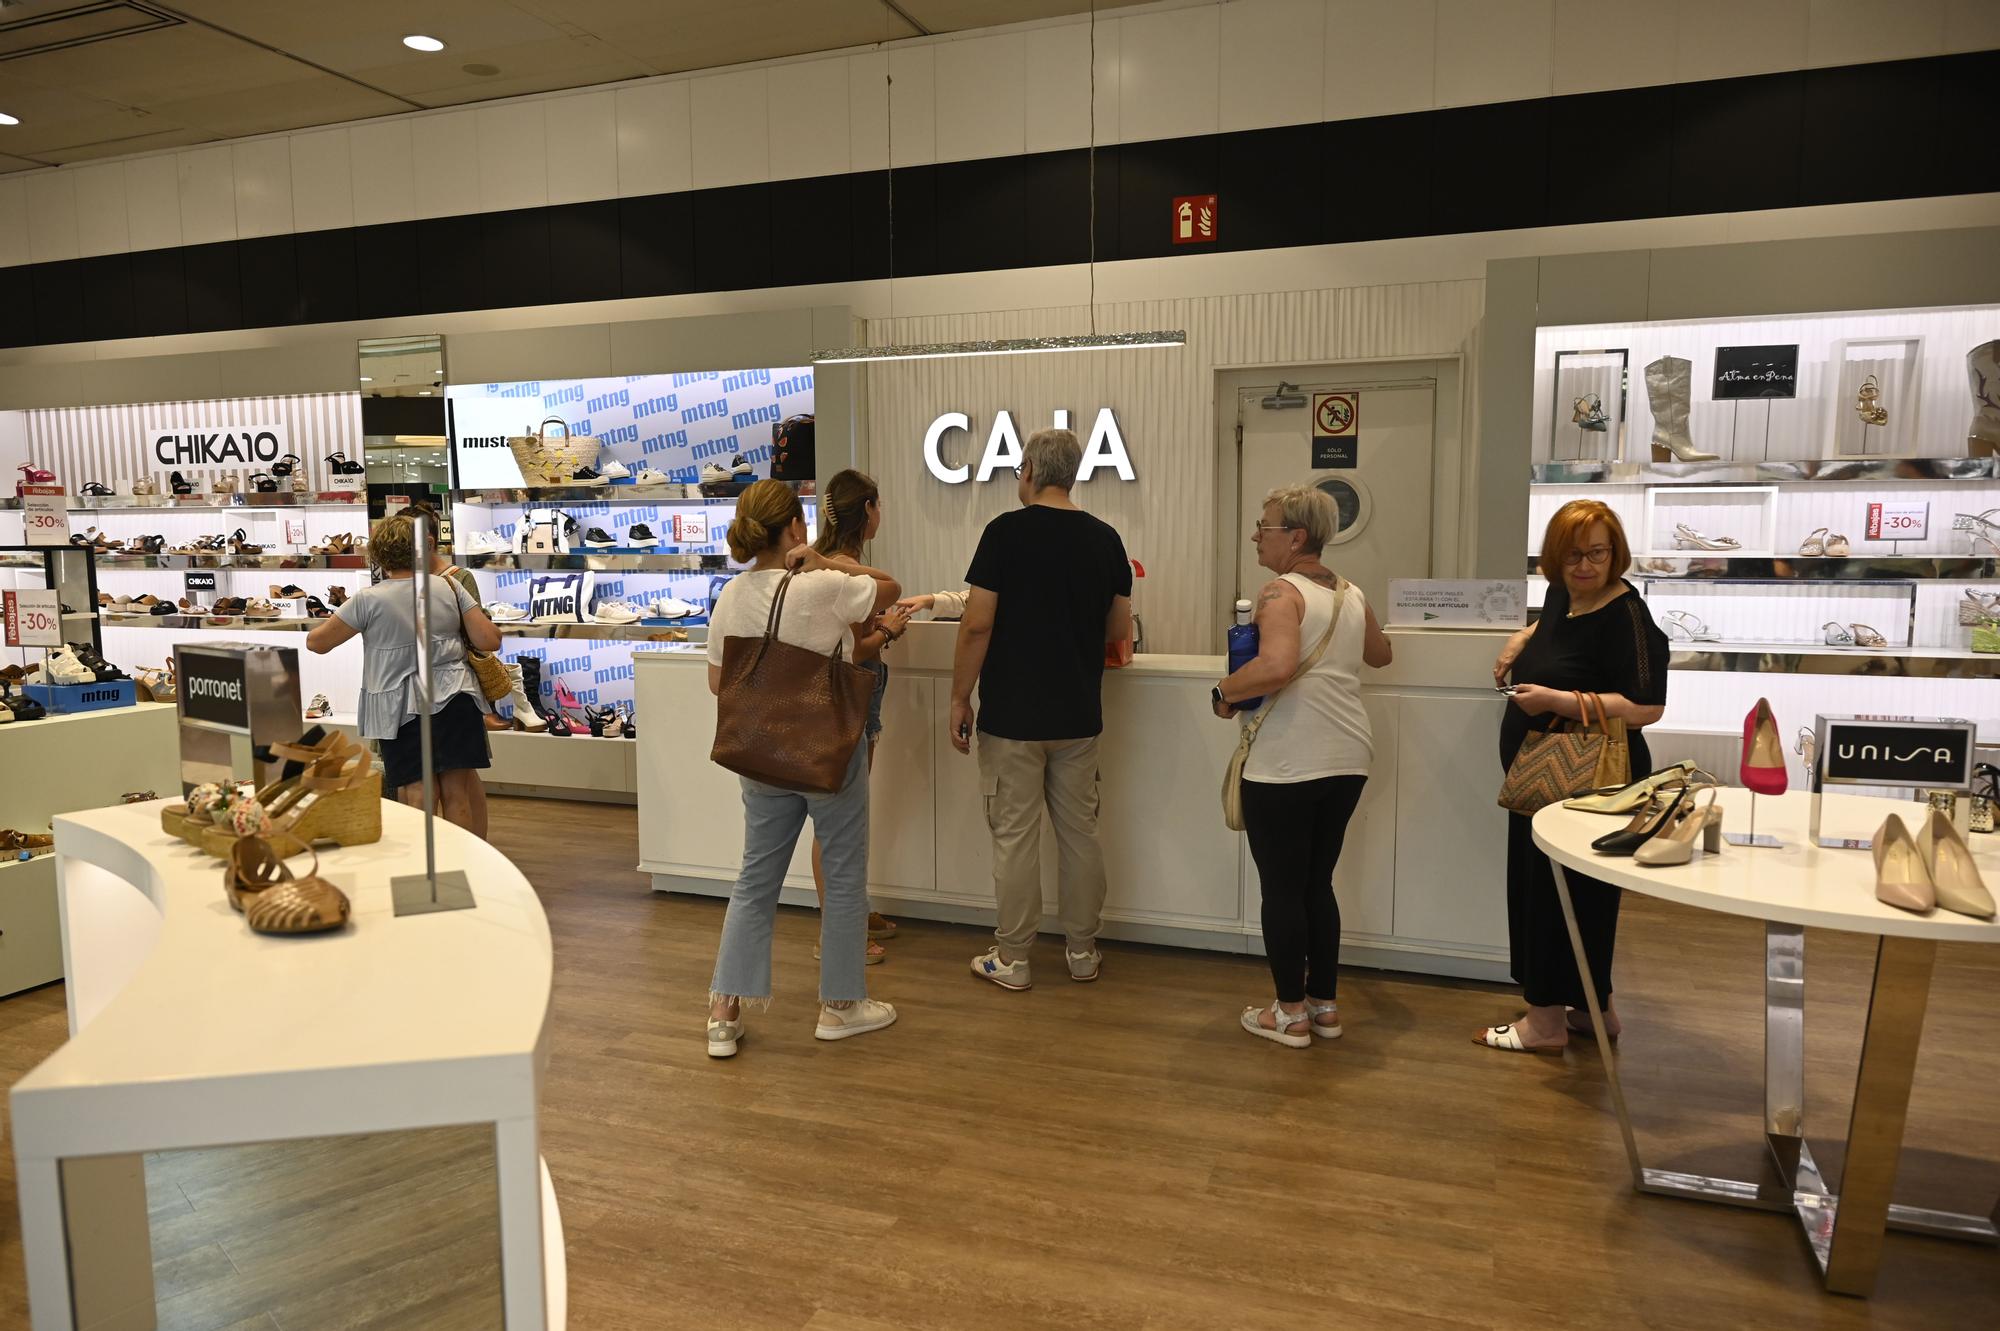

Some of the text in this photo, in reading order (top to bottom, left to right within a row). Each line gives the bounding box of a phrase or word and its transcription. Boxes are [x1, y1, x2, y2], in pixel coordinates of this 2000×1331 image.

[723, 369, 771, 393] mtng
[543, 384, 584, 408] mtng
[587, 389, 630, 414] mtng
[633, 393, 678, 419] mtng
[681, 398, 729, 424] mtng
[732, 403, 782, 430] mtng
[156, 432, 278, 465] CHIKA10
[642, 429, 688, 455] mtng
[691, 434, 740, 460] mtng
[924, 408, 1136, 484] CAA
[29, 516, 65, 528] -30%
[613, 504, 658, 528] mtng
[1884, 517, 1922, 528] -30%
[683, 525, 705, 534] -30%
[532, 595, 574, 617] MTNG
[21, 613, 57, 630] -30%
[550, 655, 592, 675] mtng
[82, 689, 120, 703] mtng
[189, 676, 242, 701] porronet
